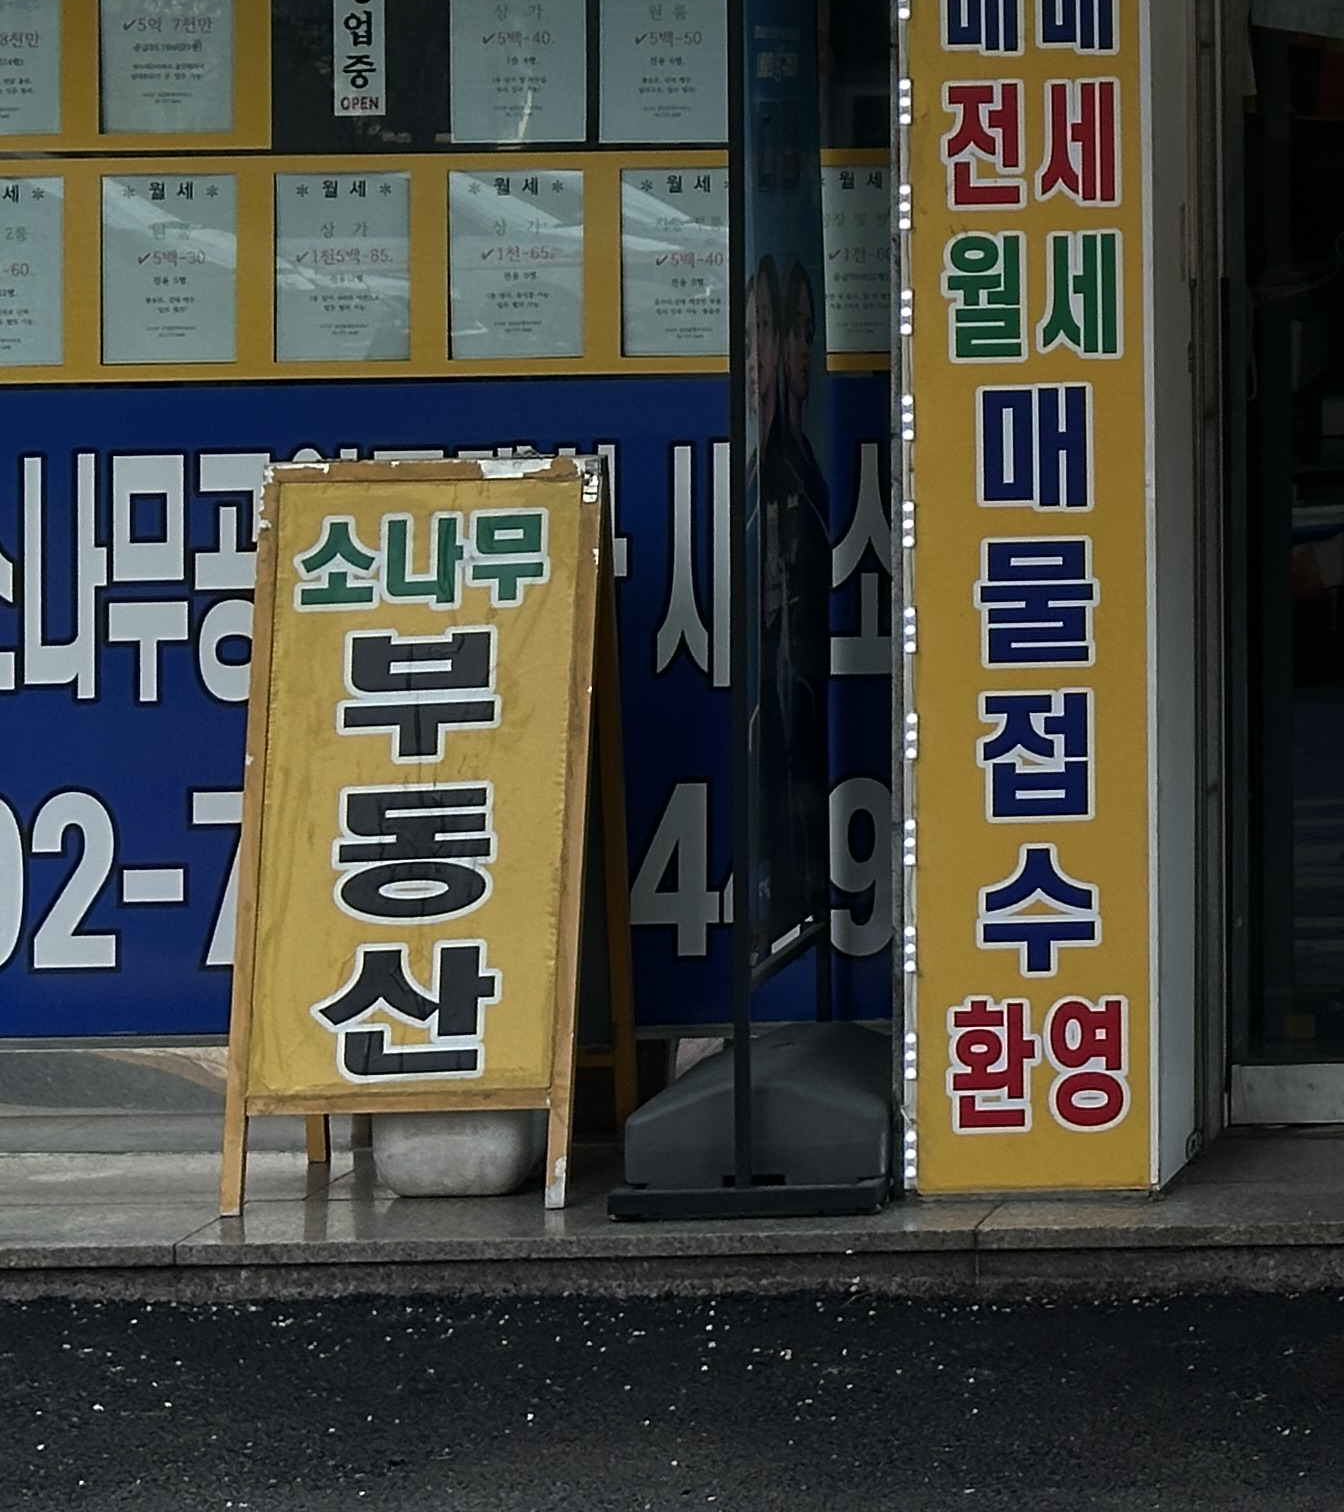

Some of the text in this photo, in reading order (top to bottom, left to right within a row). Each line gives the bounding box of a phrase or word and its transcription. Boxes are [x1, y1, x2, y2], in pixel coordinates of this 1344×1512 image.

[339, 95, 380, 112] OPEN
[941, 76, 1122, 212] 전세
[941, 228, 1124, 364] 월세
[293, 506, 550, 612] 소나무
[308, 624, 503, 1082] 부동산
[946, 994, 1131, 1134] 환영
